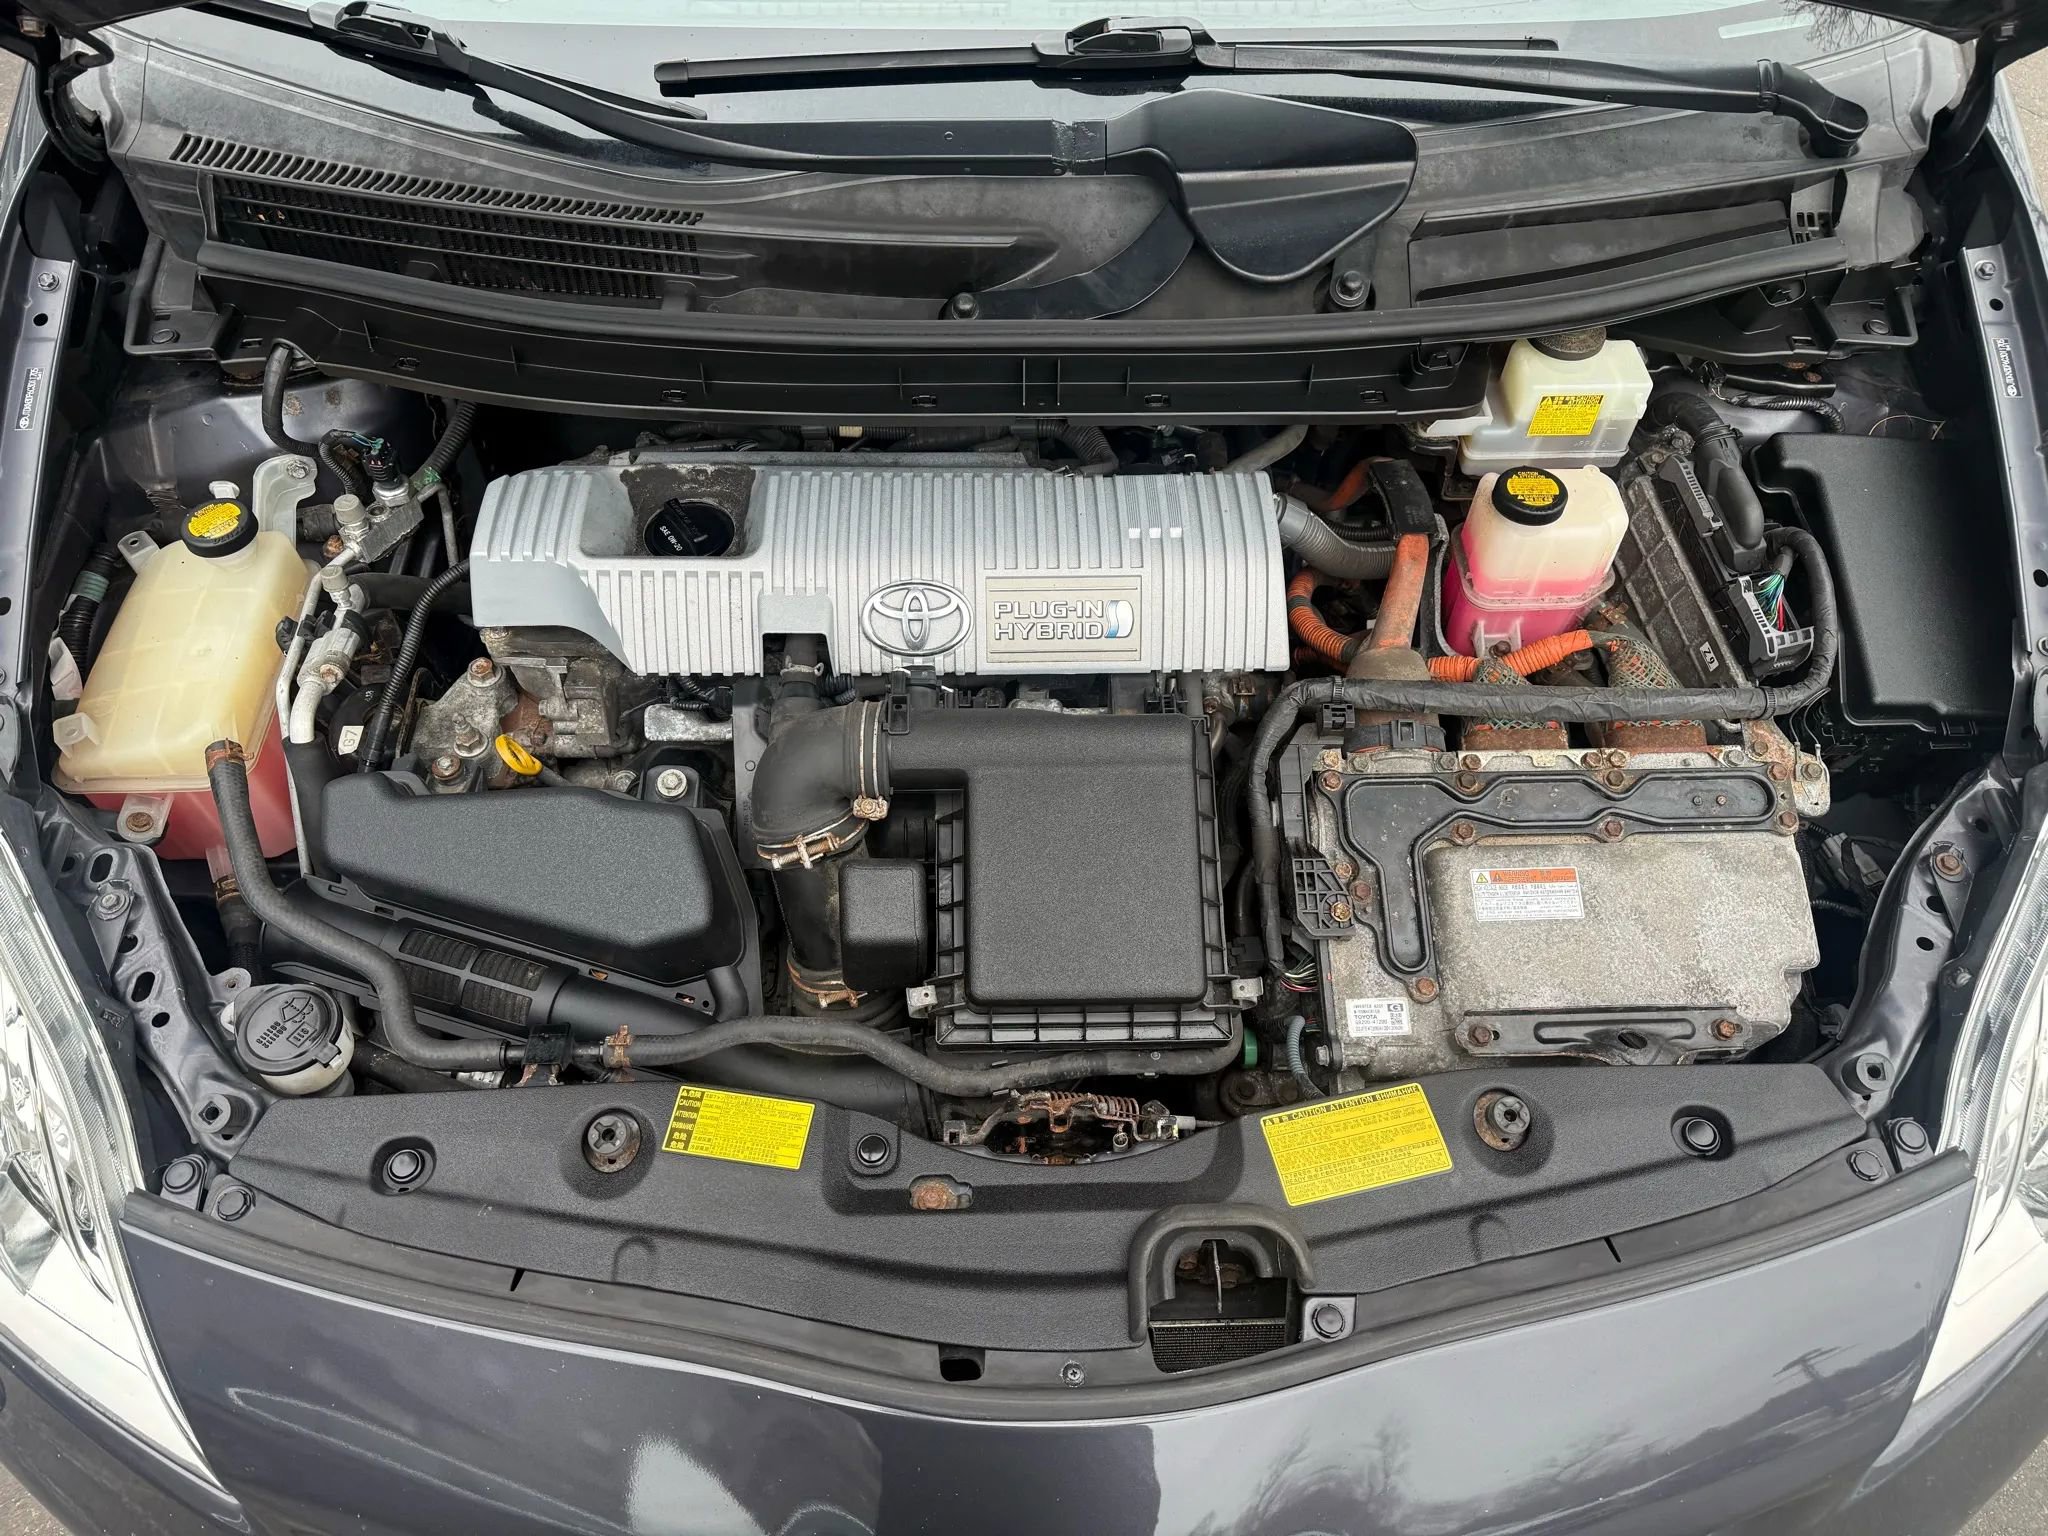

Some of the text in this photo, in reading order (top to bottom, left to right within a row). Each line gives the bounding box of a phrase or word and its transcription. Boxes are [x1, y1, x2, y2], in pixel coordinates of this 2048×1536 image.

[659, 525, 683, 552] SAE 0W-20
[993, 599, 1104, 619] PLUG-IN
[994, 621, 1104, 640] HYBRID
[342, 729, 357, 746] G7
[679, 1099, 701, 1107] CAUTION
[1292, 1106, 1327, 1120] CAUTION
[1330, 1096, 1374, 1112] ATTENTION
[675, 1110, 698, 1119] ATTENTION
